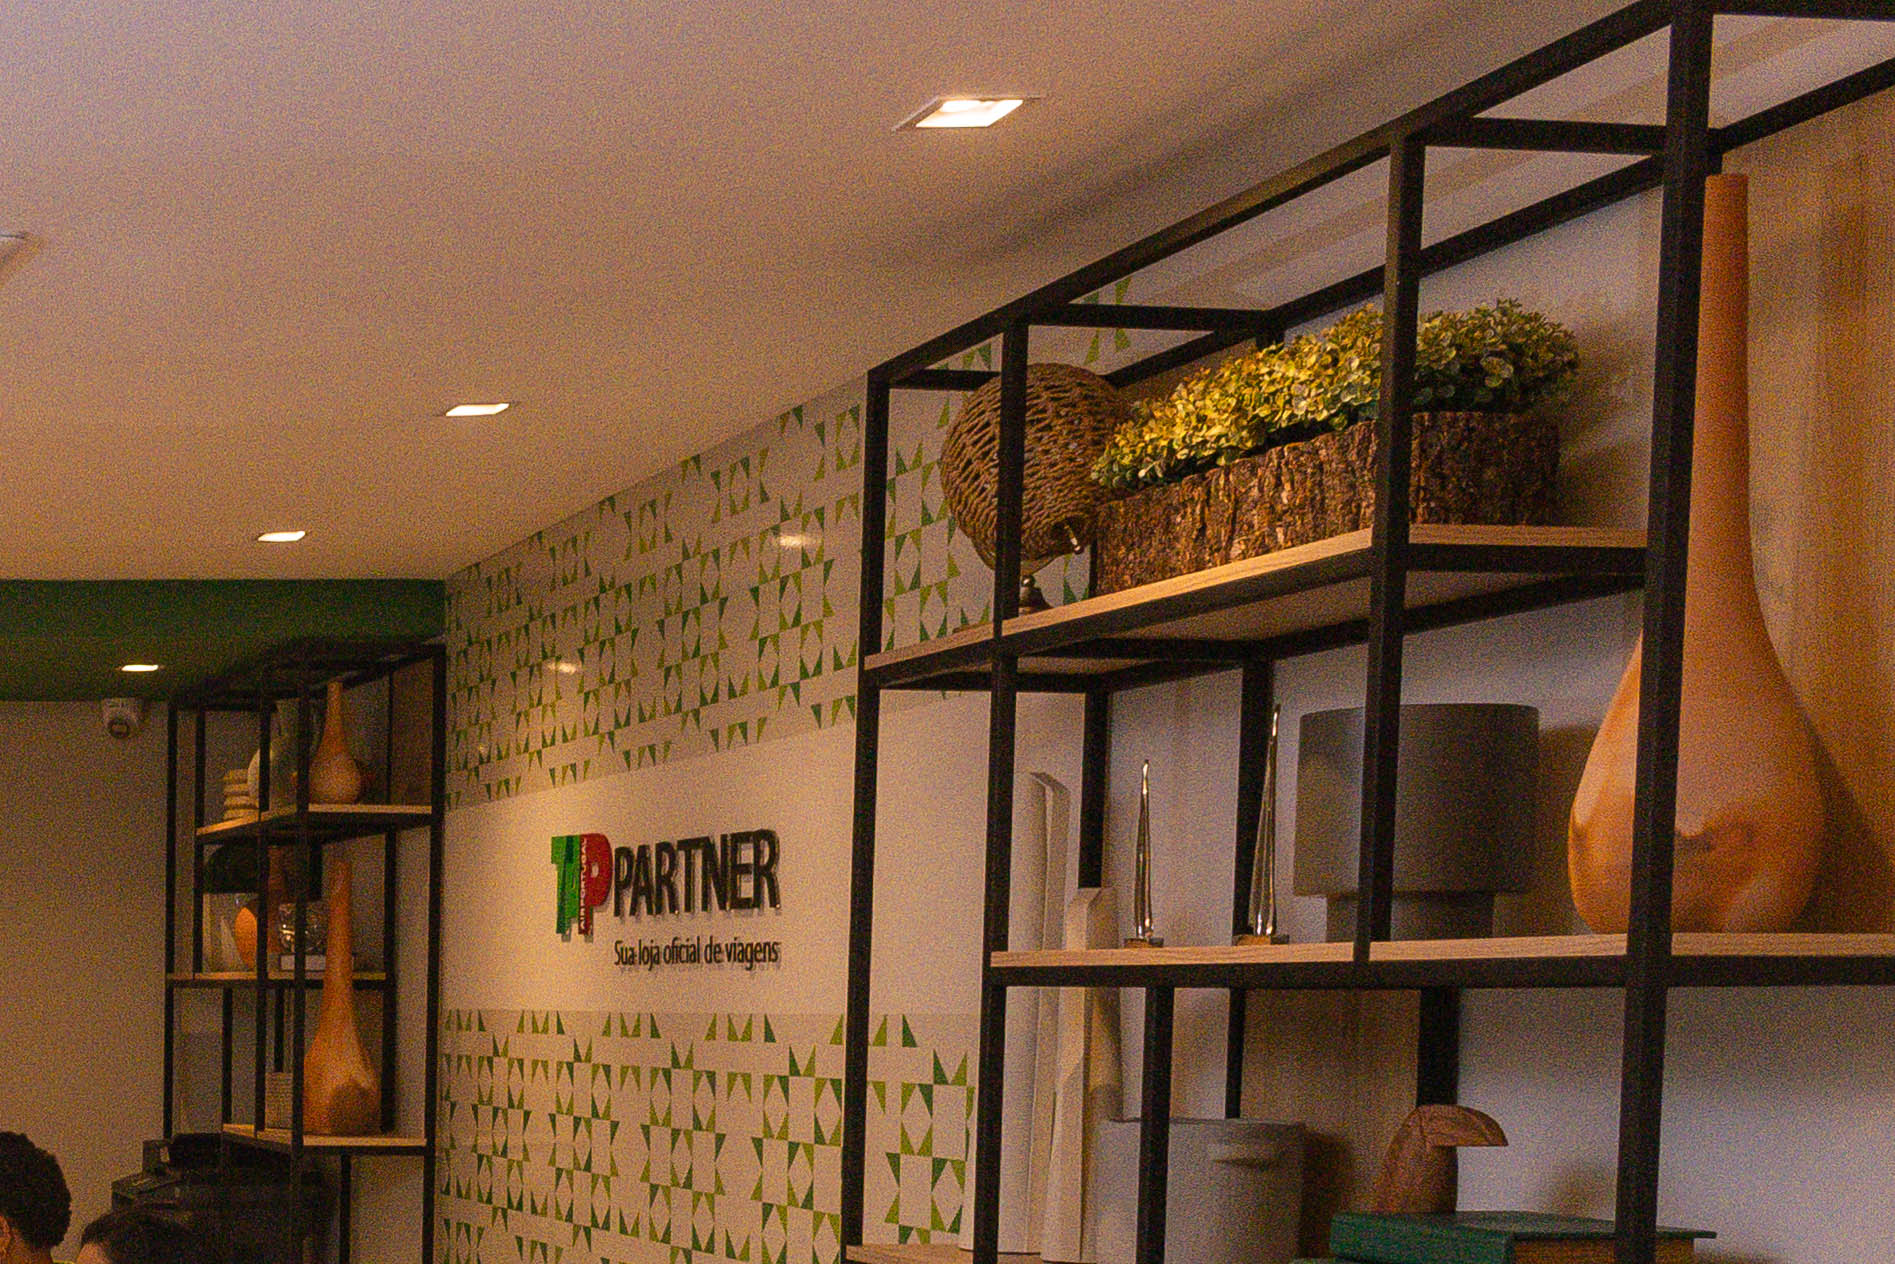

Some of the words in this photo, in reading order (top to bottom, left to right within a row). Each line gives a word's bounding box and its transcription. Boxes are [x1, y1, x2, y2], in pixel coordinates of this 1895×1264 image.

[613, 828, 781, 917] PARTNER
[614, 940, 635, 966] Sua
[638, 940, 660, 971] loja
[663, 936, 701, 965] oficial
[704, 936, 723, 963] de
[724, 937, 780, 971] viagens
